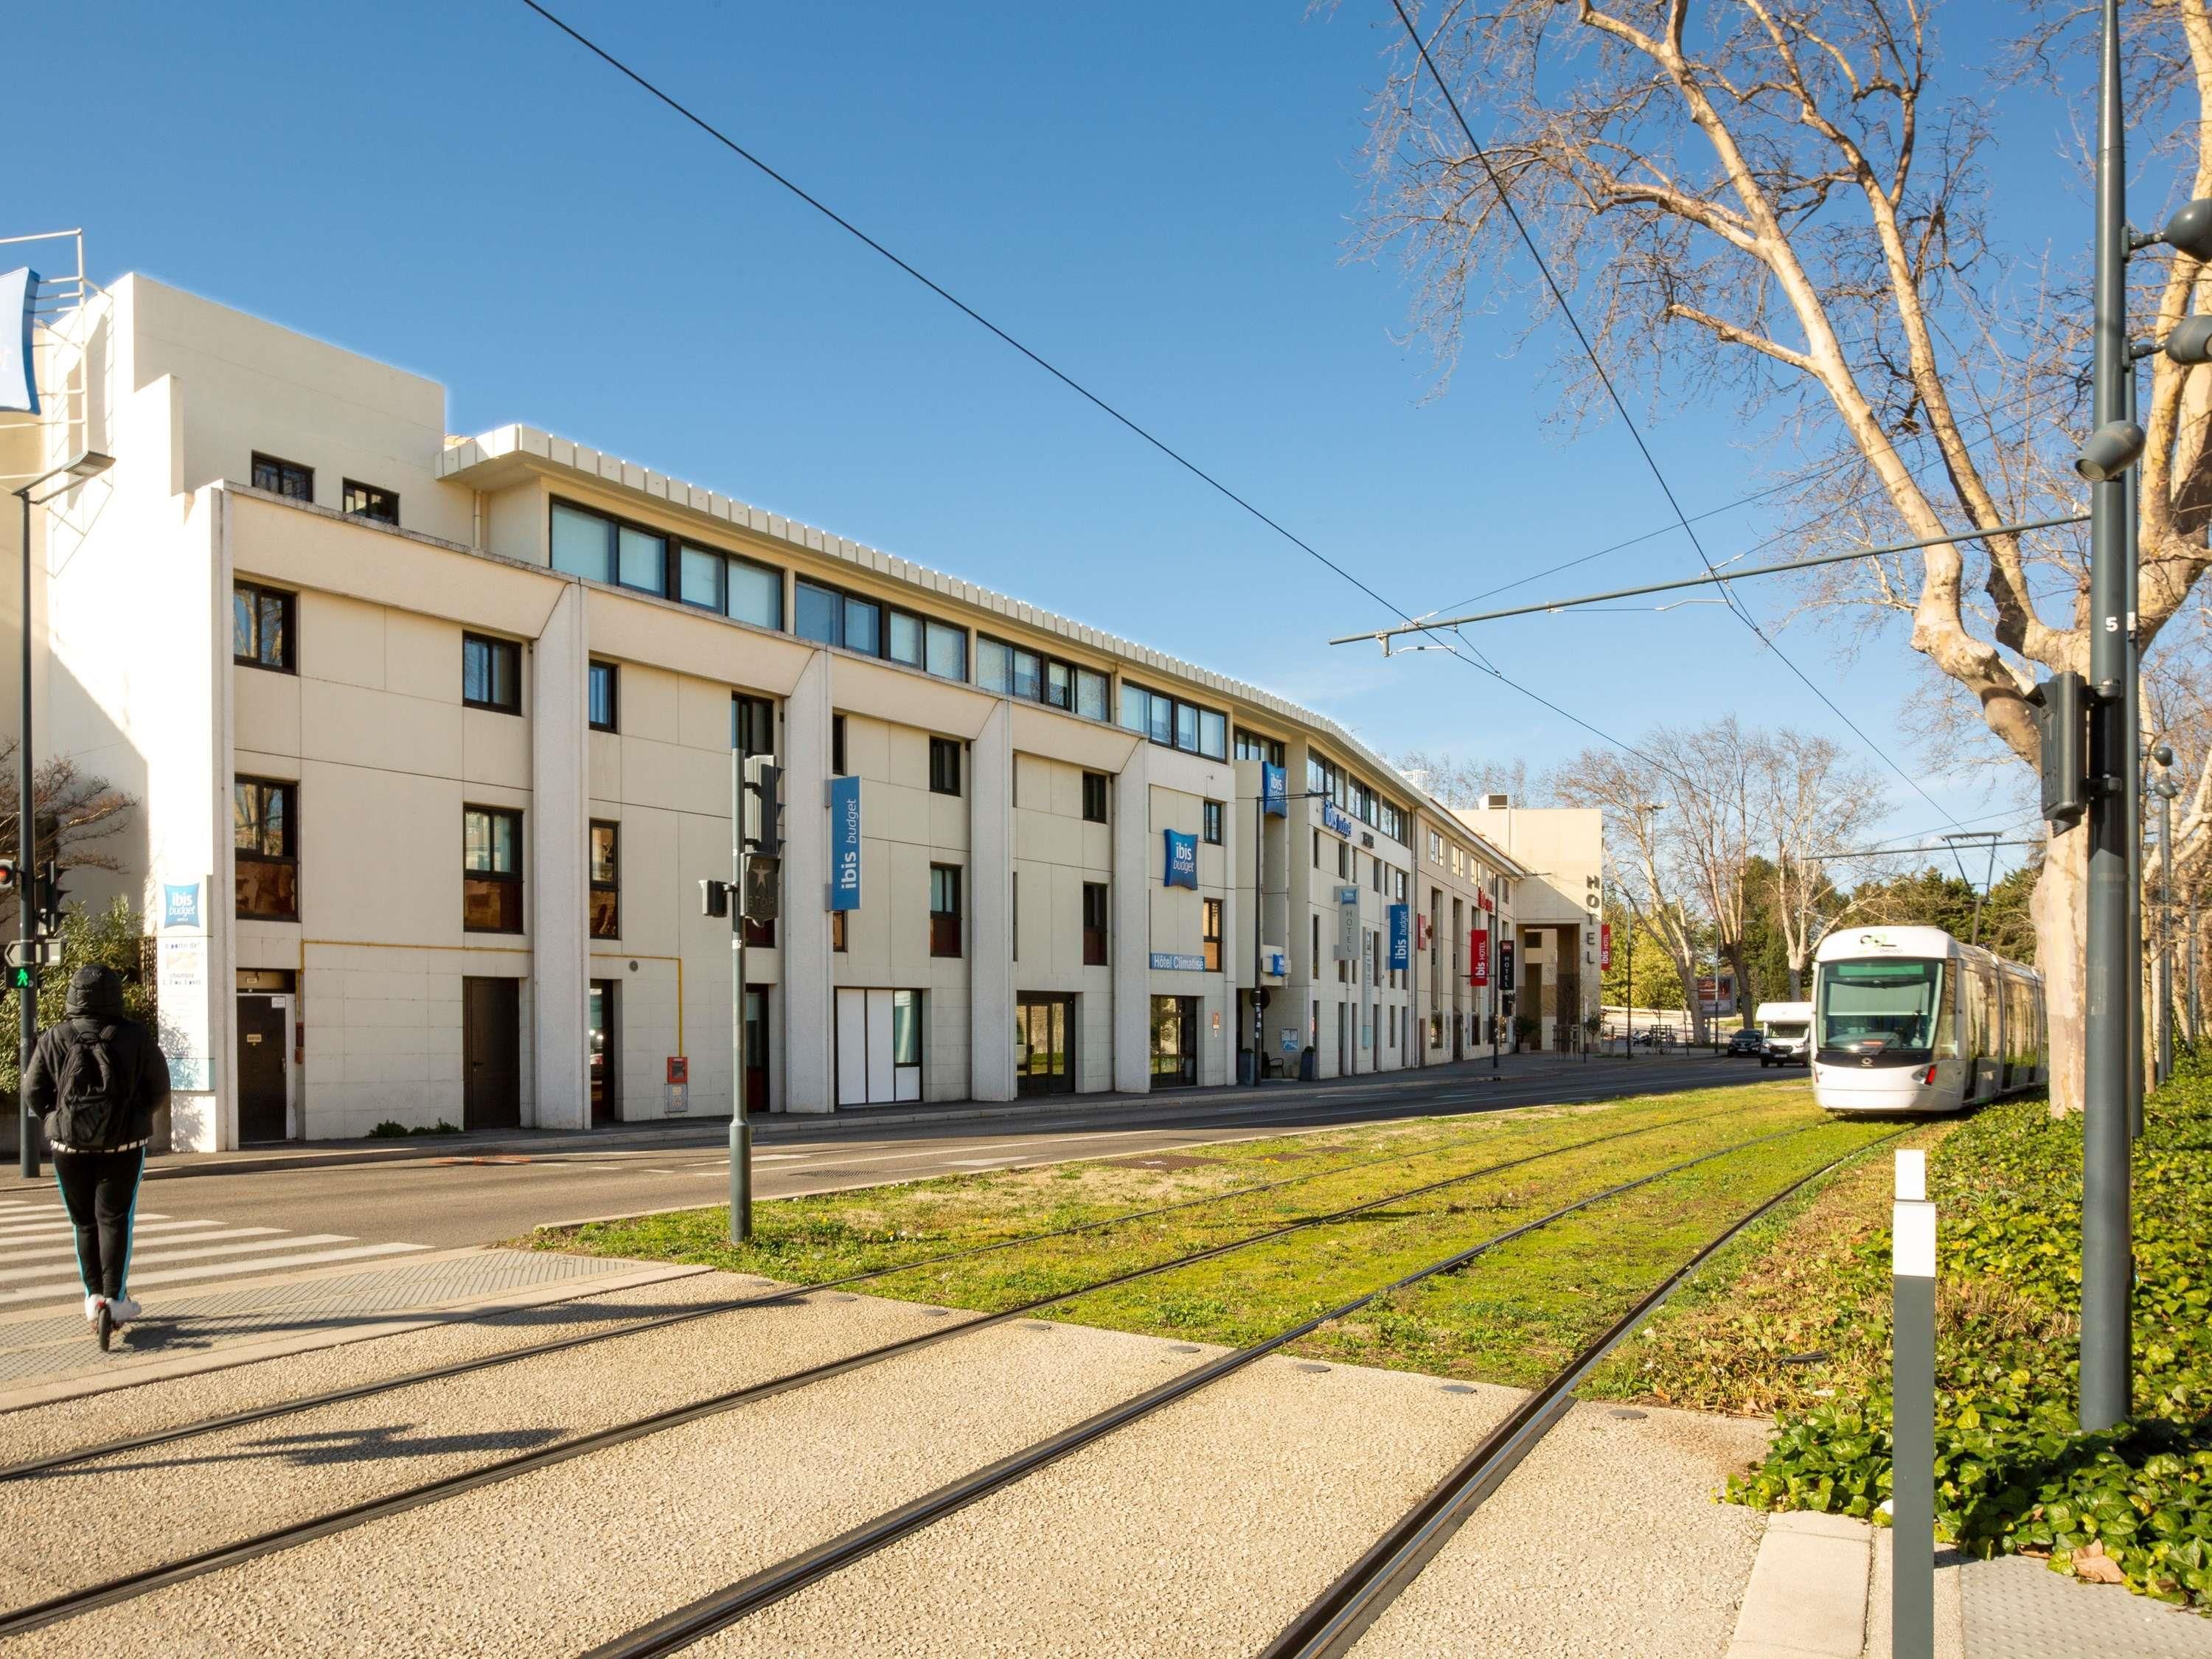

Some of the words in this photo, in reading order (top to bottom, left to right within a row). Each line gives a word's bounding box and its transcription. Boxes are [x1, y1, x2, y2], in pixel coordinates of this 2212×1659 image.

[1270, 774, 1283, 790] ibis
[846, 799, 859, 844] budget
[1175, 842, 1192, 860] ibis
[841, 851, 857, 889] ibis
[1173, 858, 1194, 874] budget
[172, 891, 193, 906] ibis
[169, 905, 195, 917] budget
[1586, 875, 1599, 964] HOTEL
[1399, 911, 1408, 936] budget
[1395, 939, 1407, 959] ibis
[1154, 954, 1172, 968] Hôtel
[1173, 956, 1204, 970] Climatisé
[1475, 961, 1486, 978] ibis
